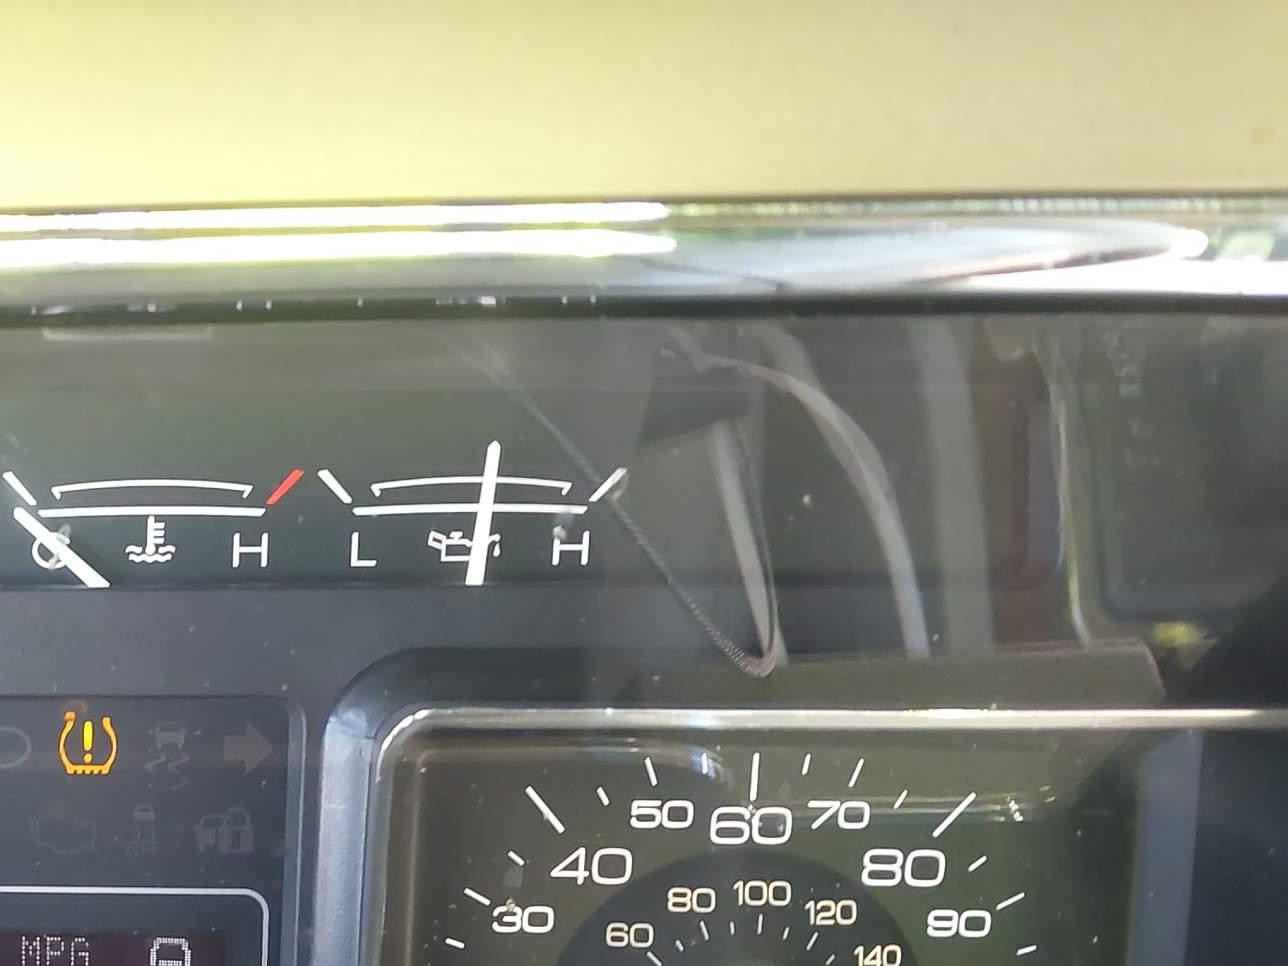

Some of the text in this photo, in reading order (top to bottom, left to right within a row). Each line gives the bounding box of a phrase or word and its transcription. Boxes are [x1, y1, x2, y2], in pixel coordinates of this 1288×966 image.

[232, 532, 269, 568] H
[350, 531, 377, 567] L
[551, 530, 590, 566] H
[629, 799, 694, 829] 50
[709, 804, 793, 845] 60
[807, 800, 871, 830] 70
[550, 847, 633, 885] 40
[861, 848, 946, 888] 80
[667, 887, 716, 913] 80
[733, 880, 792, 907] 100
[491, 901, 555, 934] 30
[804, 899, 857, 926] 120
[926, 909, 992, 938] 90
[605, 922, 654, 948] 60
